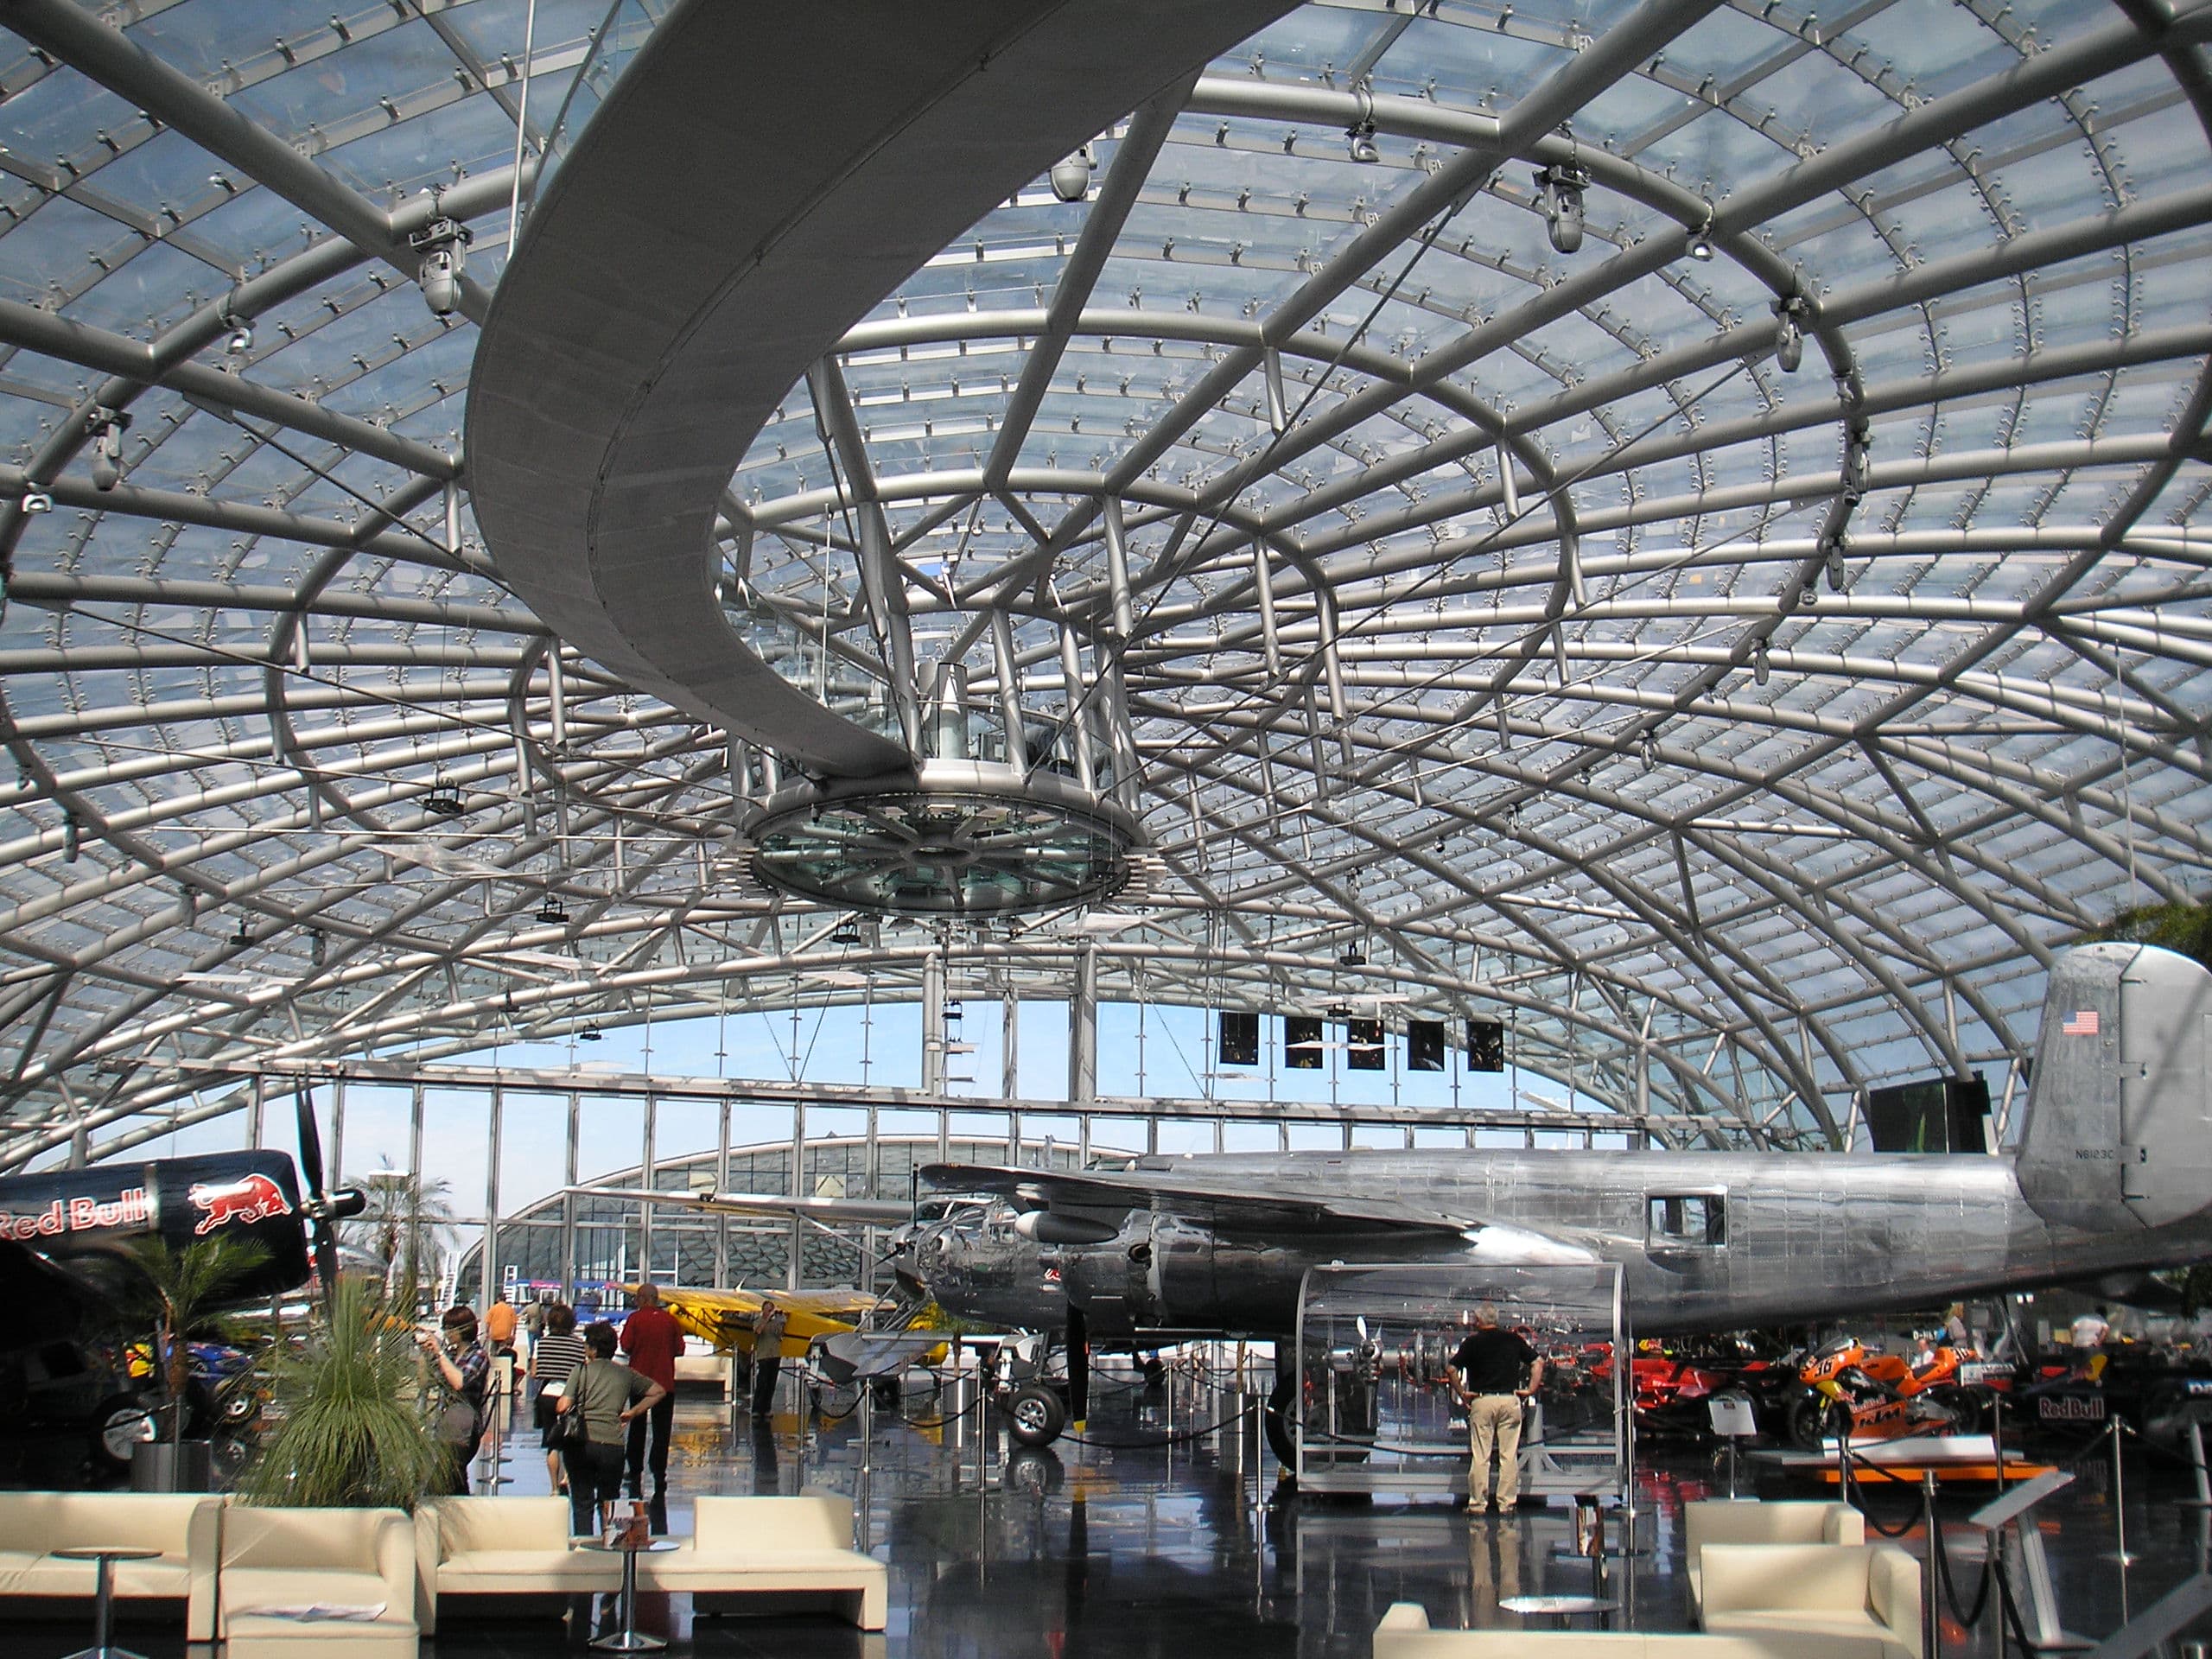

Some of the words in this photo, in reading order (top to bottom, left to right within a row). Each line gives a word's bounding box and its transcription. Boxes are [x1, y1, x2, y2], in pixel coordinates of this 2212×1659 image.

[2075, 1148, 2113, 1160] N6123C
[0, 1199, 64, 1240] Red
[70, 1187, 148, 1230] Bull
[2039, 1396, 2071, 1419] Red
[2071, 1396, 2105, 1419] Bull
